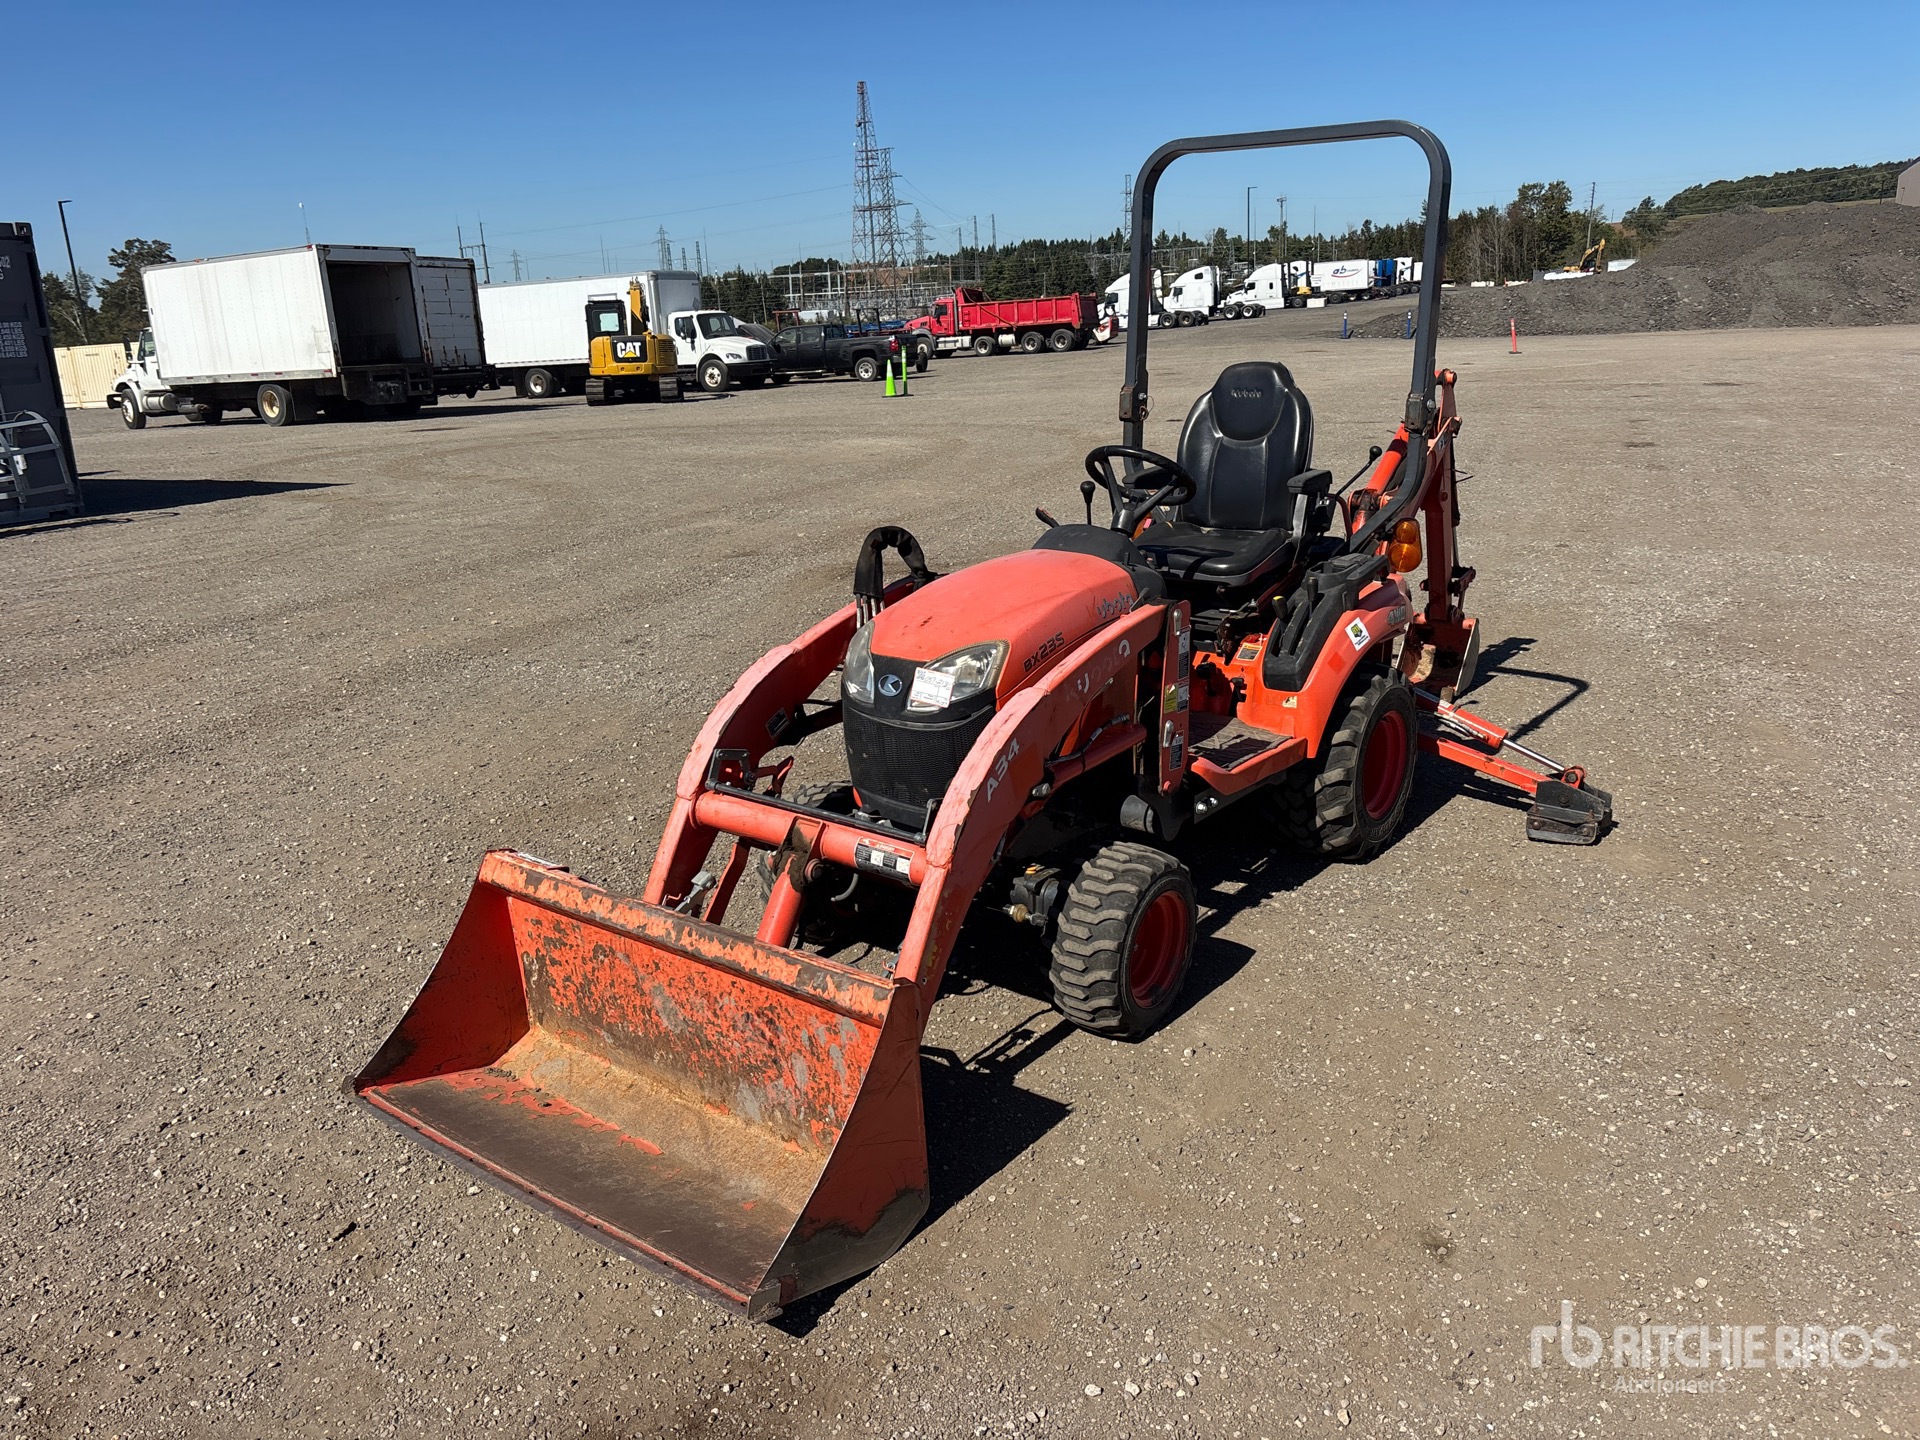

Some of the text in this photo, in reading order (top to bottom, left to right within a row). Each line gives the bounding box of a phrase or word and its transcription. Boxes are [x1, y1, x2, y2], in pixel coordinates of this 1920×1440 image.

[616, 341, 641, 358] CAT
[1023, 632, 1065, 672] BX23S
[987, 738, 1020, 803] A34
